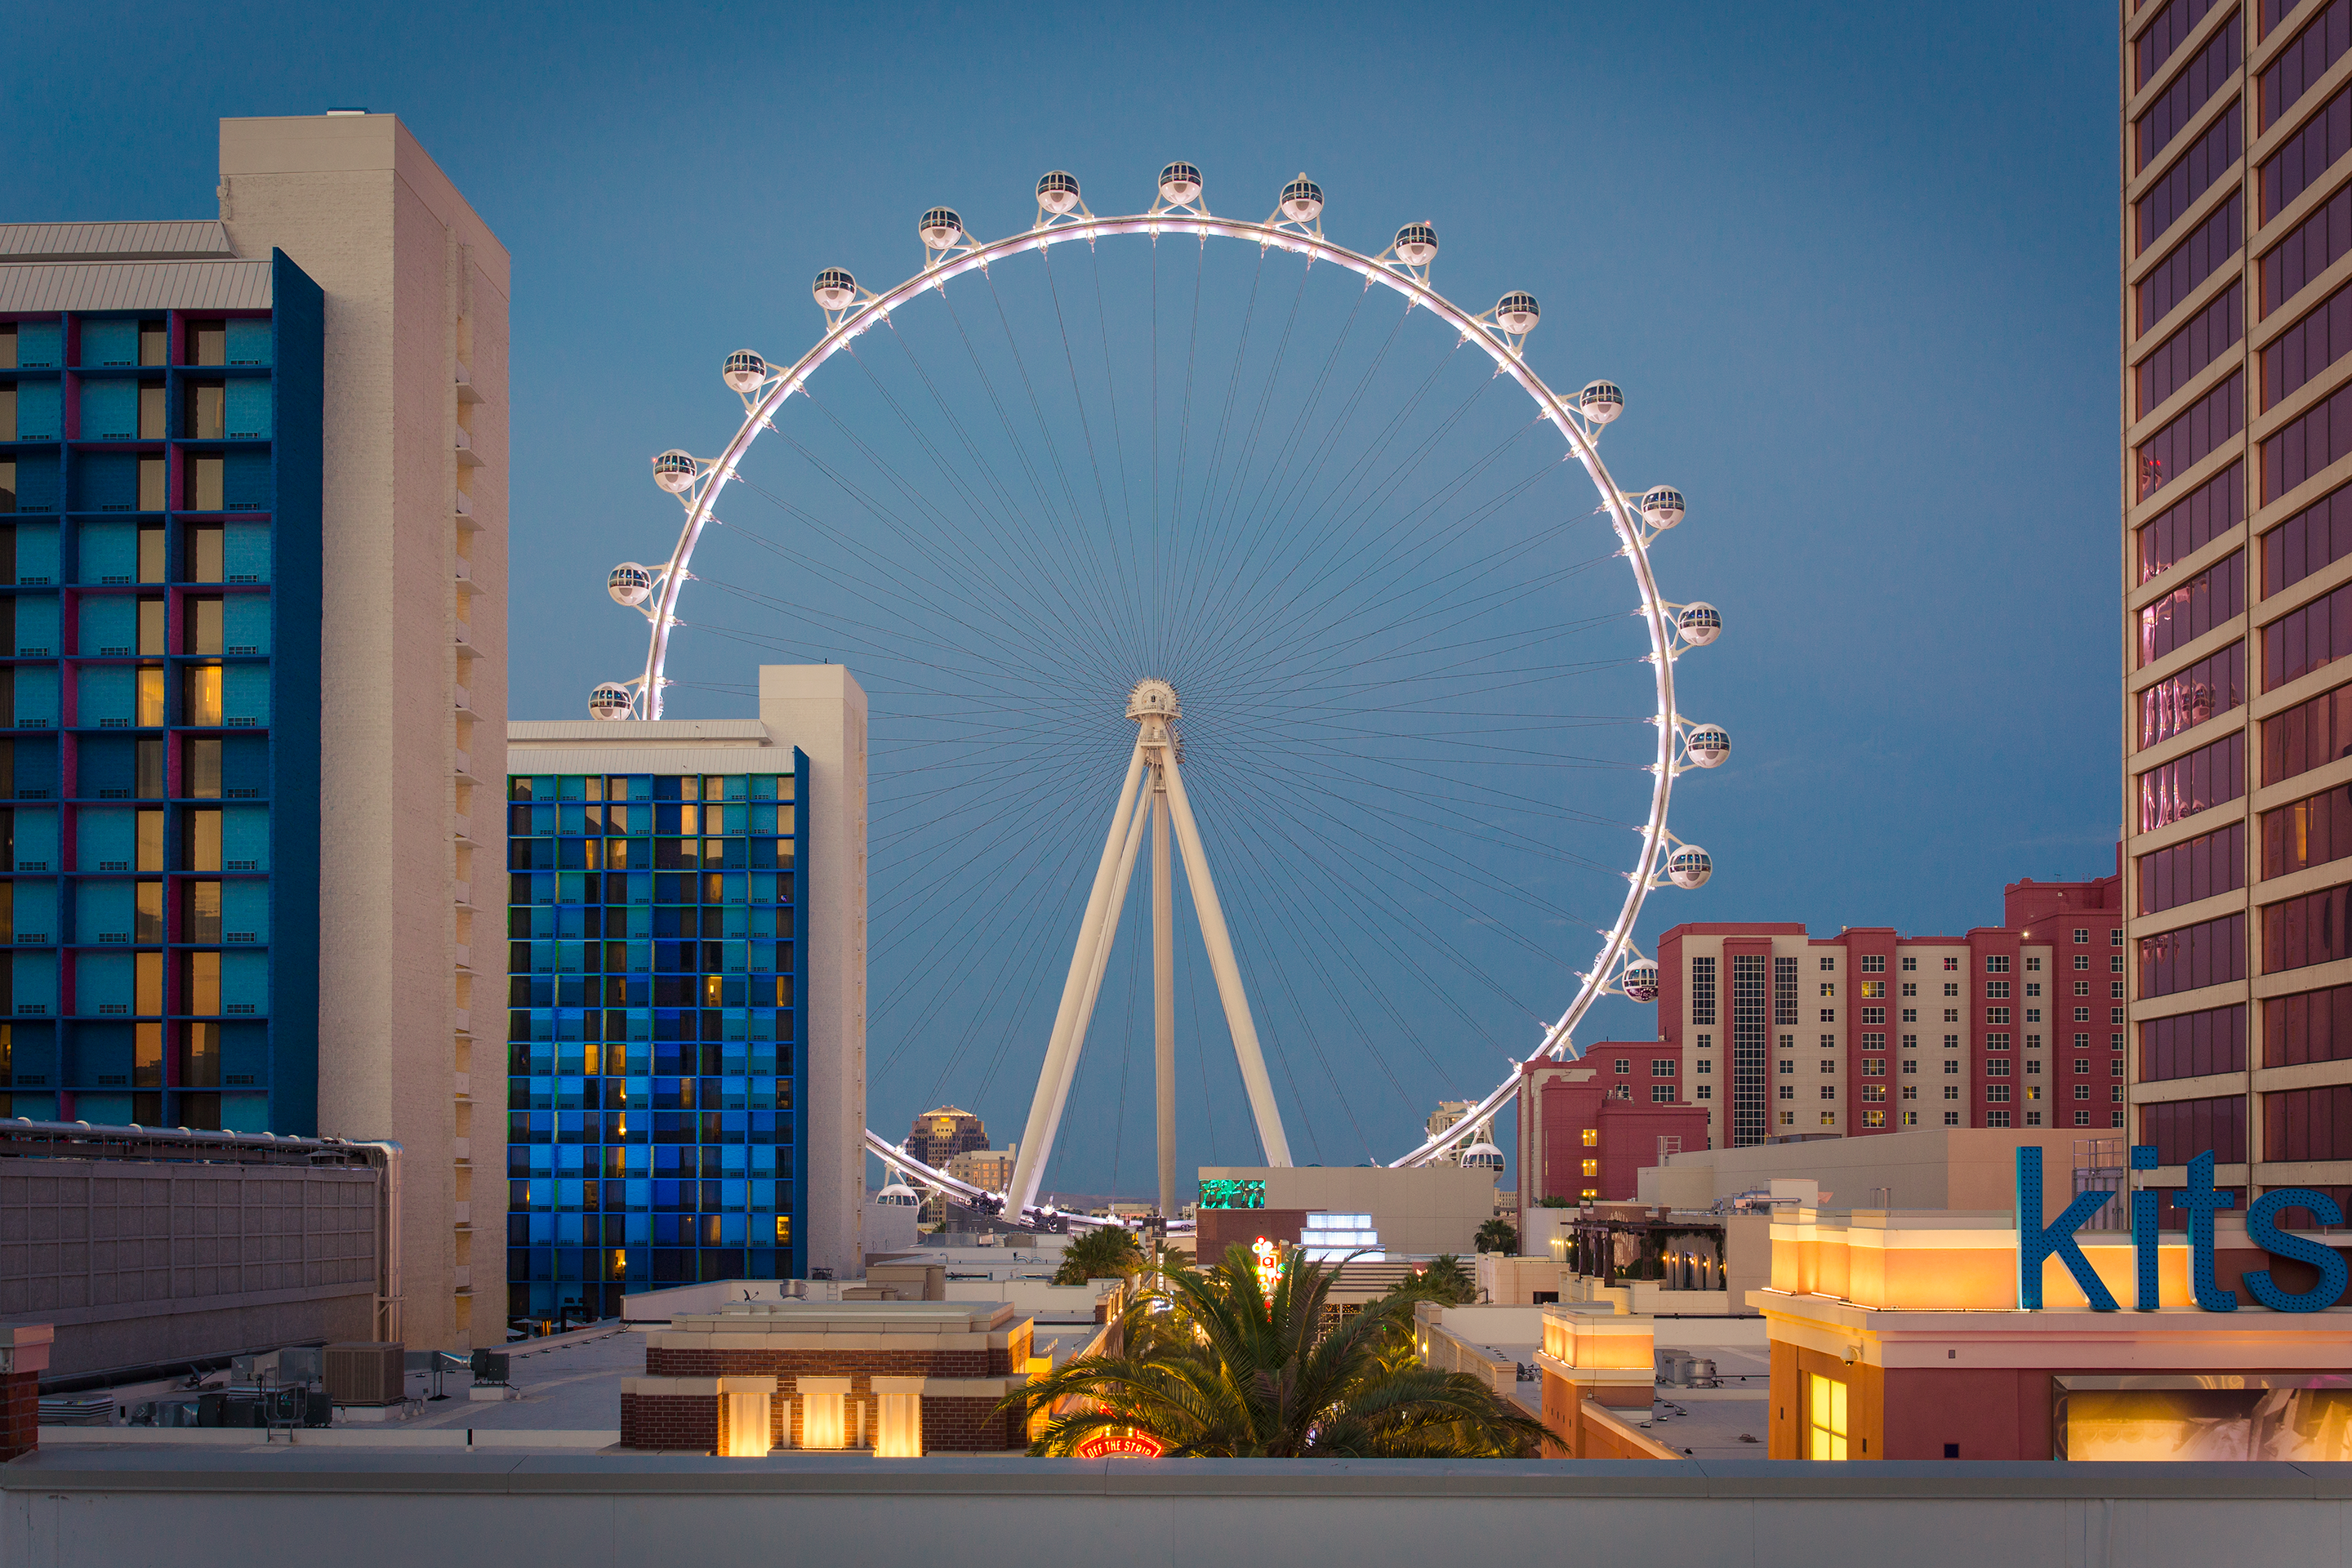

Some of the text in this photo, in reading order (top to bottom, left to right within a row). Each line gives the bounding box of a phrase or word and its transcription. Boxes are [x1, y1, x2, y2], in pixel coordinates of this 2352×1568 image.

[2016, 1145, 2350, 1313] kits
[1086, 1440, 1152, 1459] OFF THE STRIP
